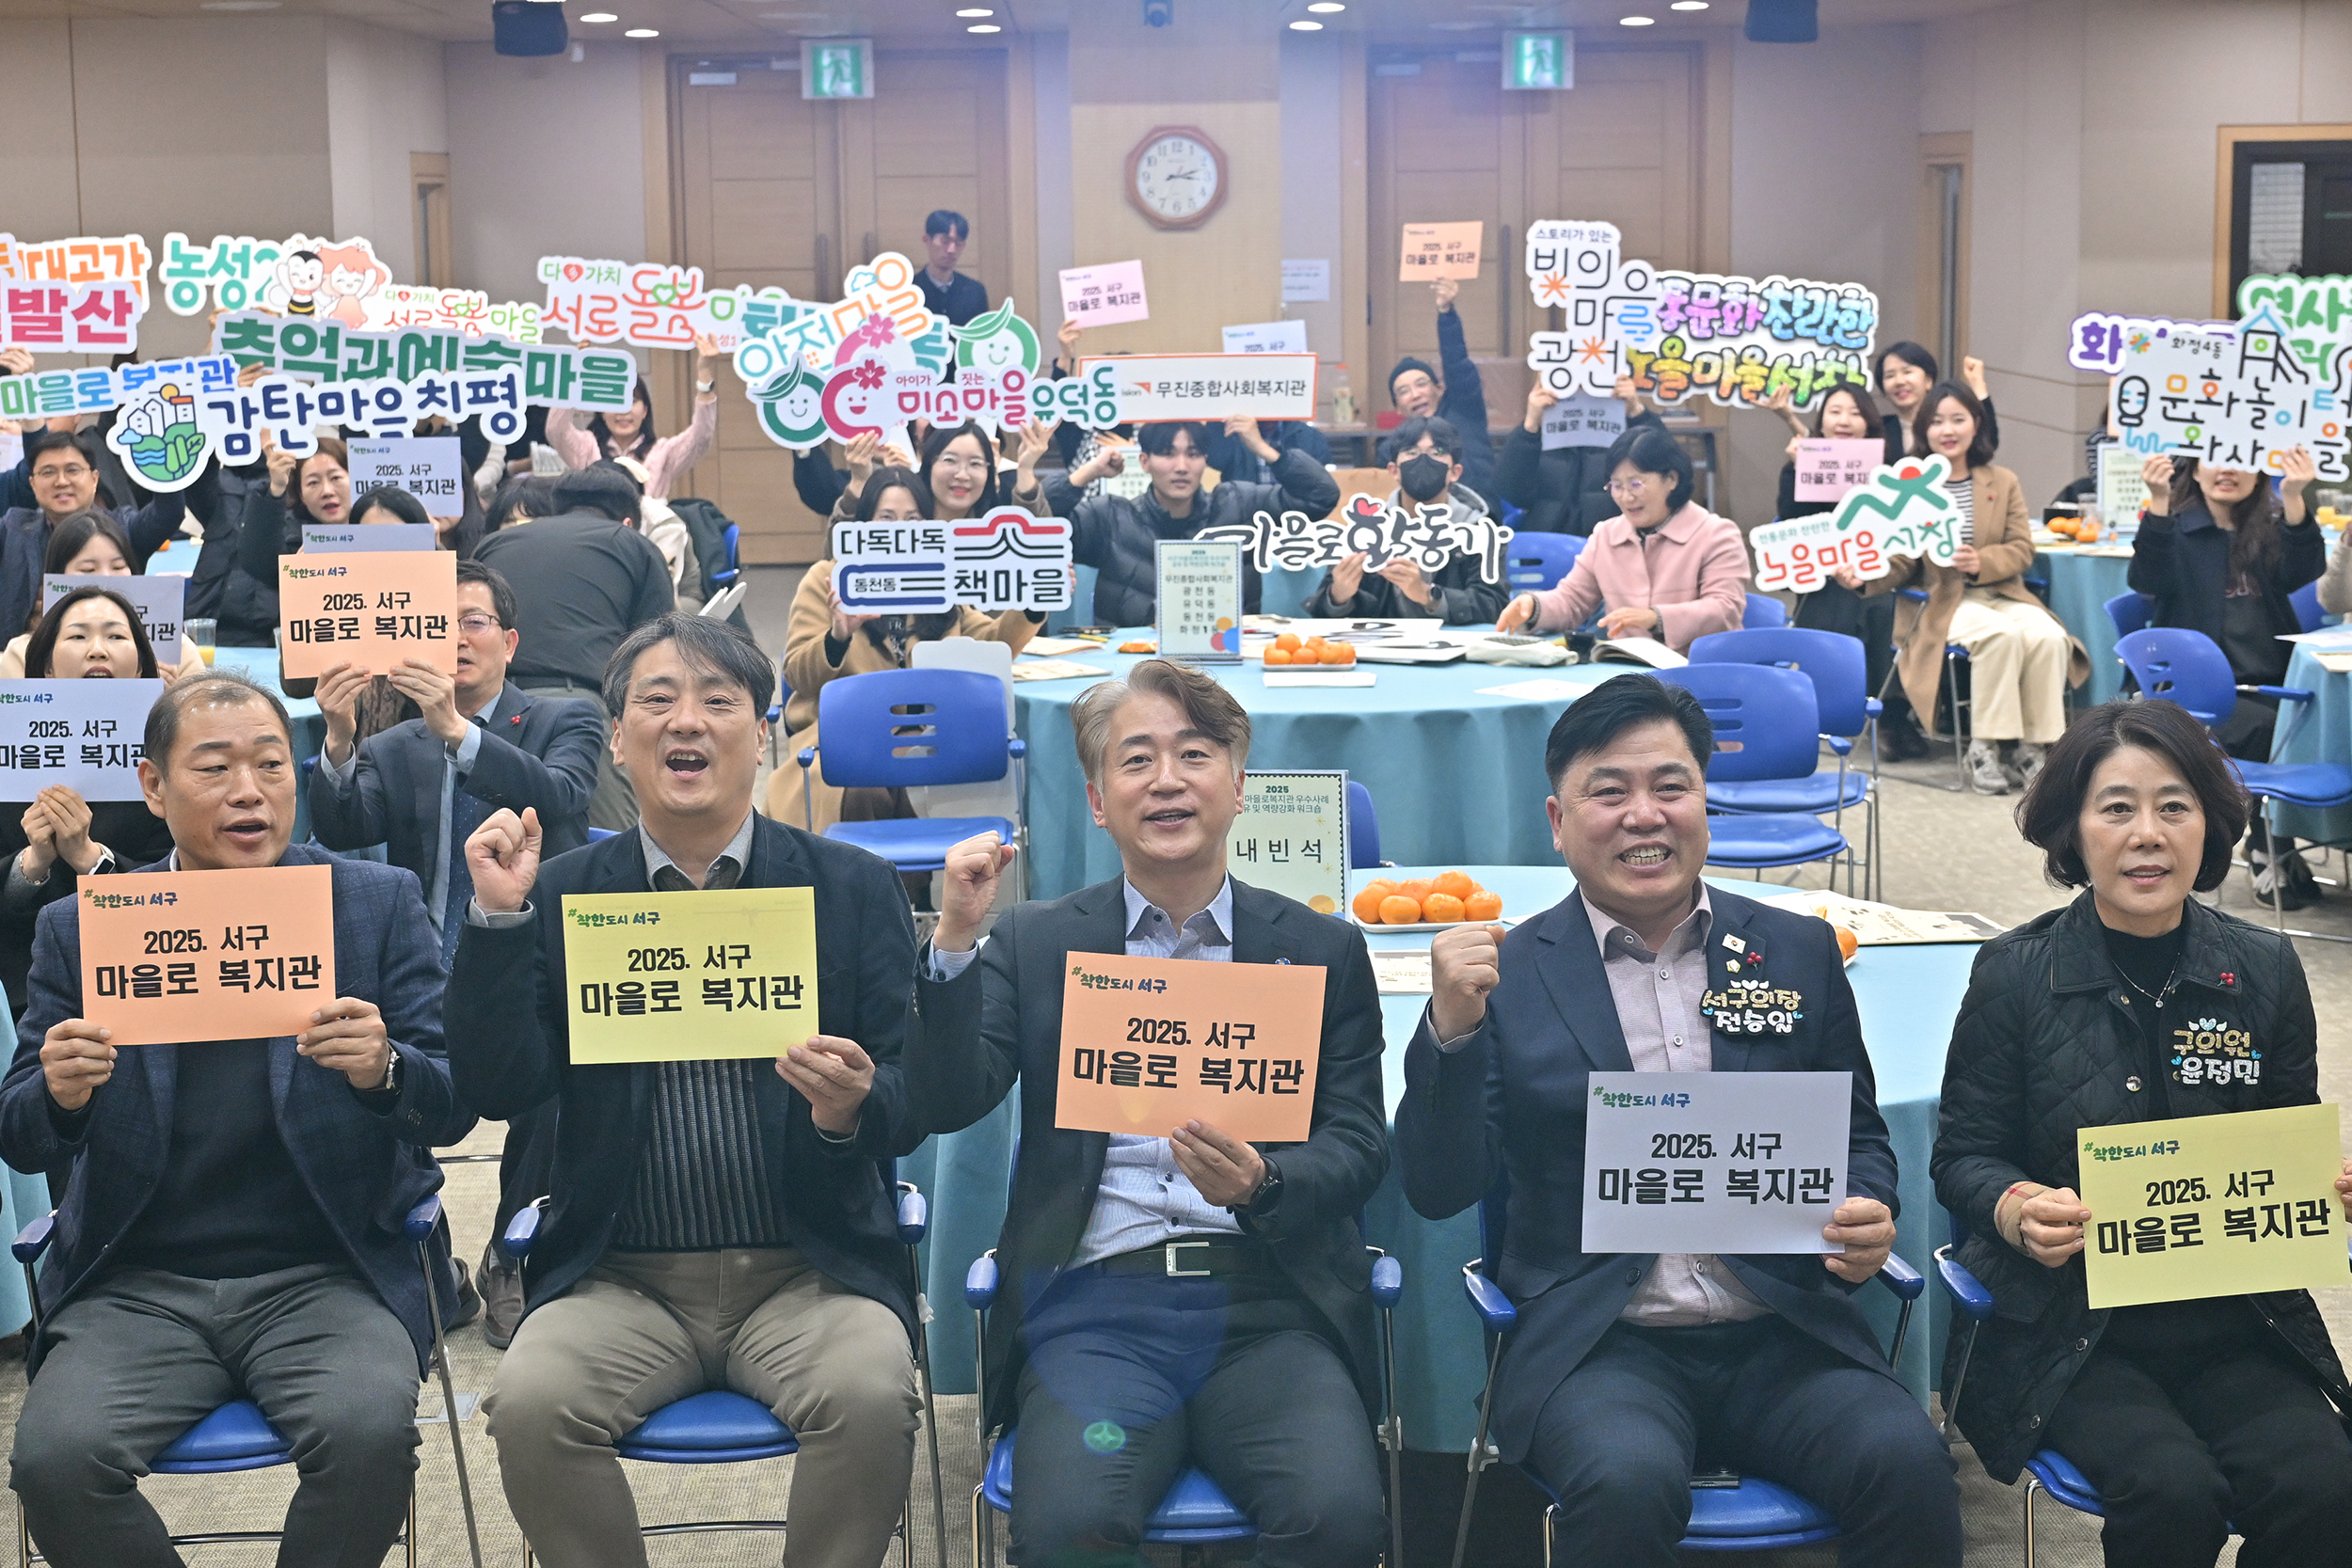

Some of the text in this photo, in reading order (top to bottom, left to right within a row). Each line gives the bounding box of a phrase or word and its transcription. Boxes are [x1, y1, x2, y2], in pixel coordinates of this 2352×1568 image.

[1534, 229, 1613, 243] 스토리가 있는
[17, 242, 145, 282] 대고가
[541, 293, 620, 336] 서로
[1068, 293, 1141, 312] 마을로 복지관
[8, 288, 133, 344] 발산
[491, 308, 538, 344] 마을
[2171, 337, 2222, 359] 화정4동
[1, 372, 114, 414] 마을로
[896, 373, 985, 388] 아이가 짓는
[1156, 379, 1307, 399] 무진종합사회복지관
[417, 372, 517, 436] 치평
[898, 366, 1117, 425] 미소마을 유덕동
[376, 464, 432, 477] 2025. 서구
[1801, 472, 1869, 484] 마을로 복지
[409, 479, 456, 495] 복지관
[340, 534, 355, 543] 서구
[841, 529, 946, 555] 다독다독
[1763, 531, 1881, 585] 노을마을
[283, 564, 347, 578] #착한도시 서구
[854, 578, 897, 593] 동천동
[954, 569, 1065, 604] 책마을
[323, 592, 412, 611] 2025. 서구
[144, 623, 176, 641] 지관
[290, 615, 449, 643] 마을로 복지관
[34, 693, 54, 704] 서구
[28, 720, 118, 738] 2025. 서구
[0, 744, 66, 769] 마을로
[1245, 795, 1329, 804] 마을로복지관 우수사례
[1252, 804, 1261, 813] 및
[1262, 804, 1295, 814] 역량강화
[1297, 804, 1322, 814] 워크숍
[84, 889, 178, 909] #착한도시 서구
[568, 909, 660, 927] #착한도시 서구
[144, 925, 269, 955] 2025. 서구
[628, 944, 752, 973] 2025. 서구
[96, 955, 322, 999] 마을로 복지관
[1072, 966, 1168, 993] #착한도시 서구
[580, 974, 804, 1017] 마을로 복지관
[1702, 989, 1802, 1011] 서구의장
[1126, 1017, 1256, 1050] 2025. 서구
[1714, 1009, 1794, 1033] 전승일
[2173, 1029, 2251, 1057] 구의원
[1073, 1048, 1305, 1095] 마을로 복지관
[2181, 1056, 2260, 1085] 윤정민
[1593, 1085, 1691, 1108] #착한도시 서구
[1651, 1132, 1782, 1160] 2025. 서구
[2084, 1140, 2181, 1162] #착한도시 서구
[1598, 1167, 1834, 1205] 마을로 복지관
[2146, 1169, 2275, 1207] 2025. 서구
[2097, 1198, 2331, 1257] 마을로 복지관
